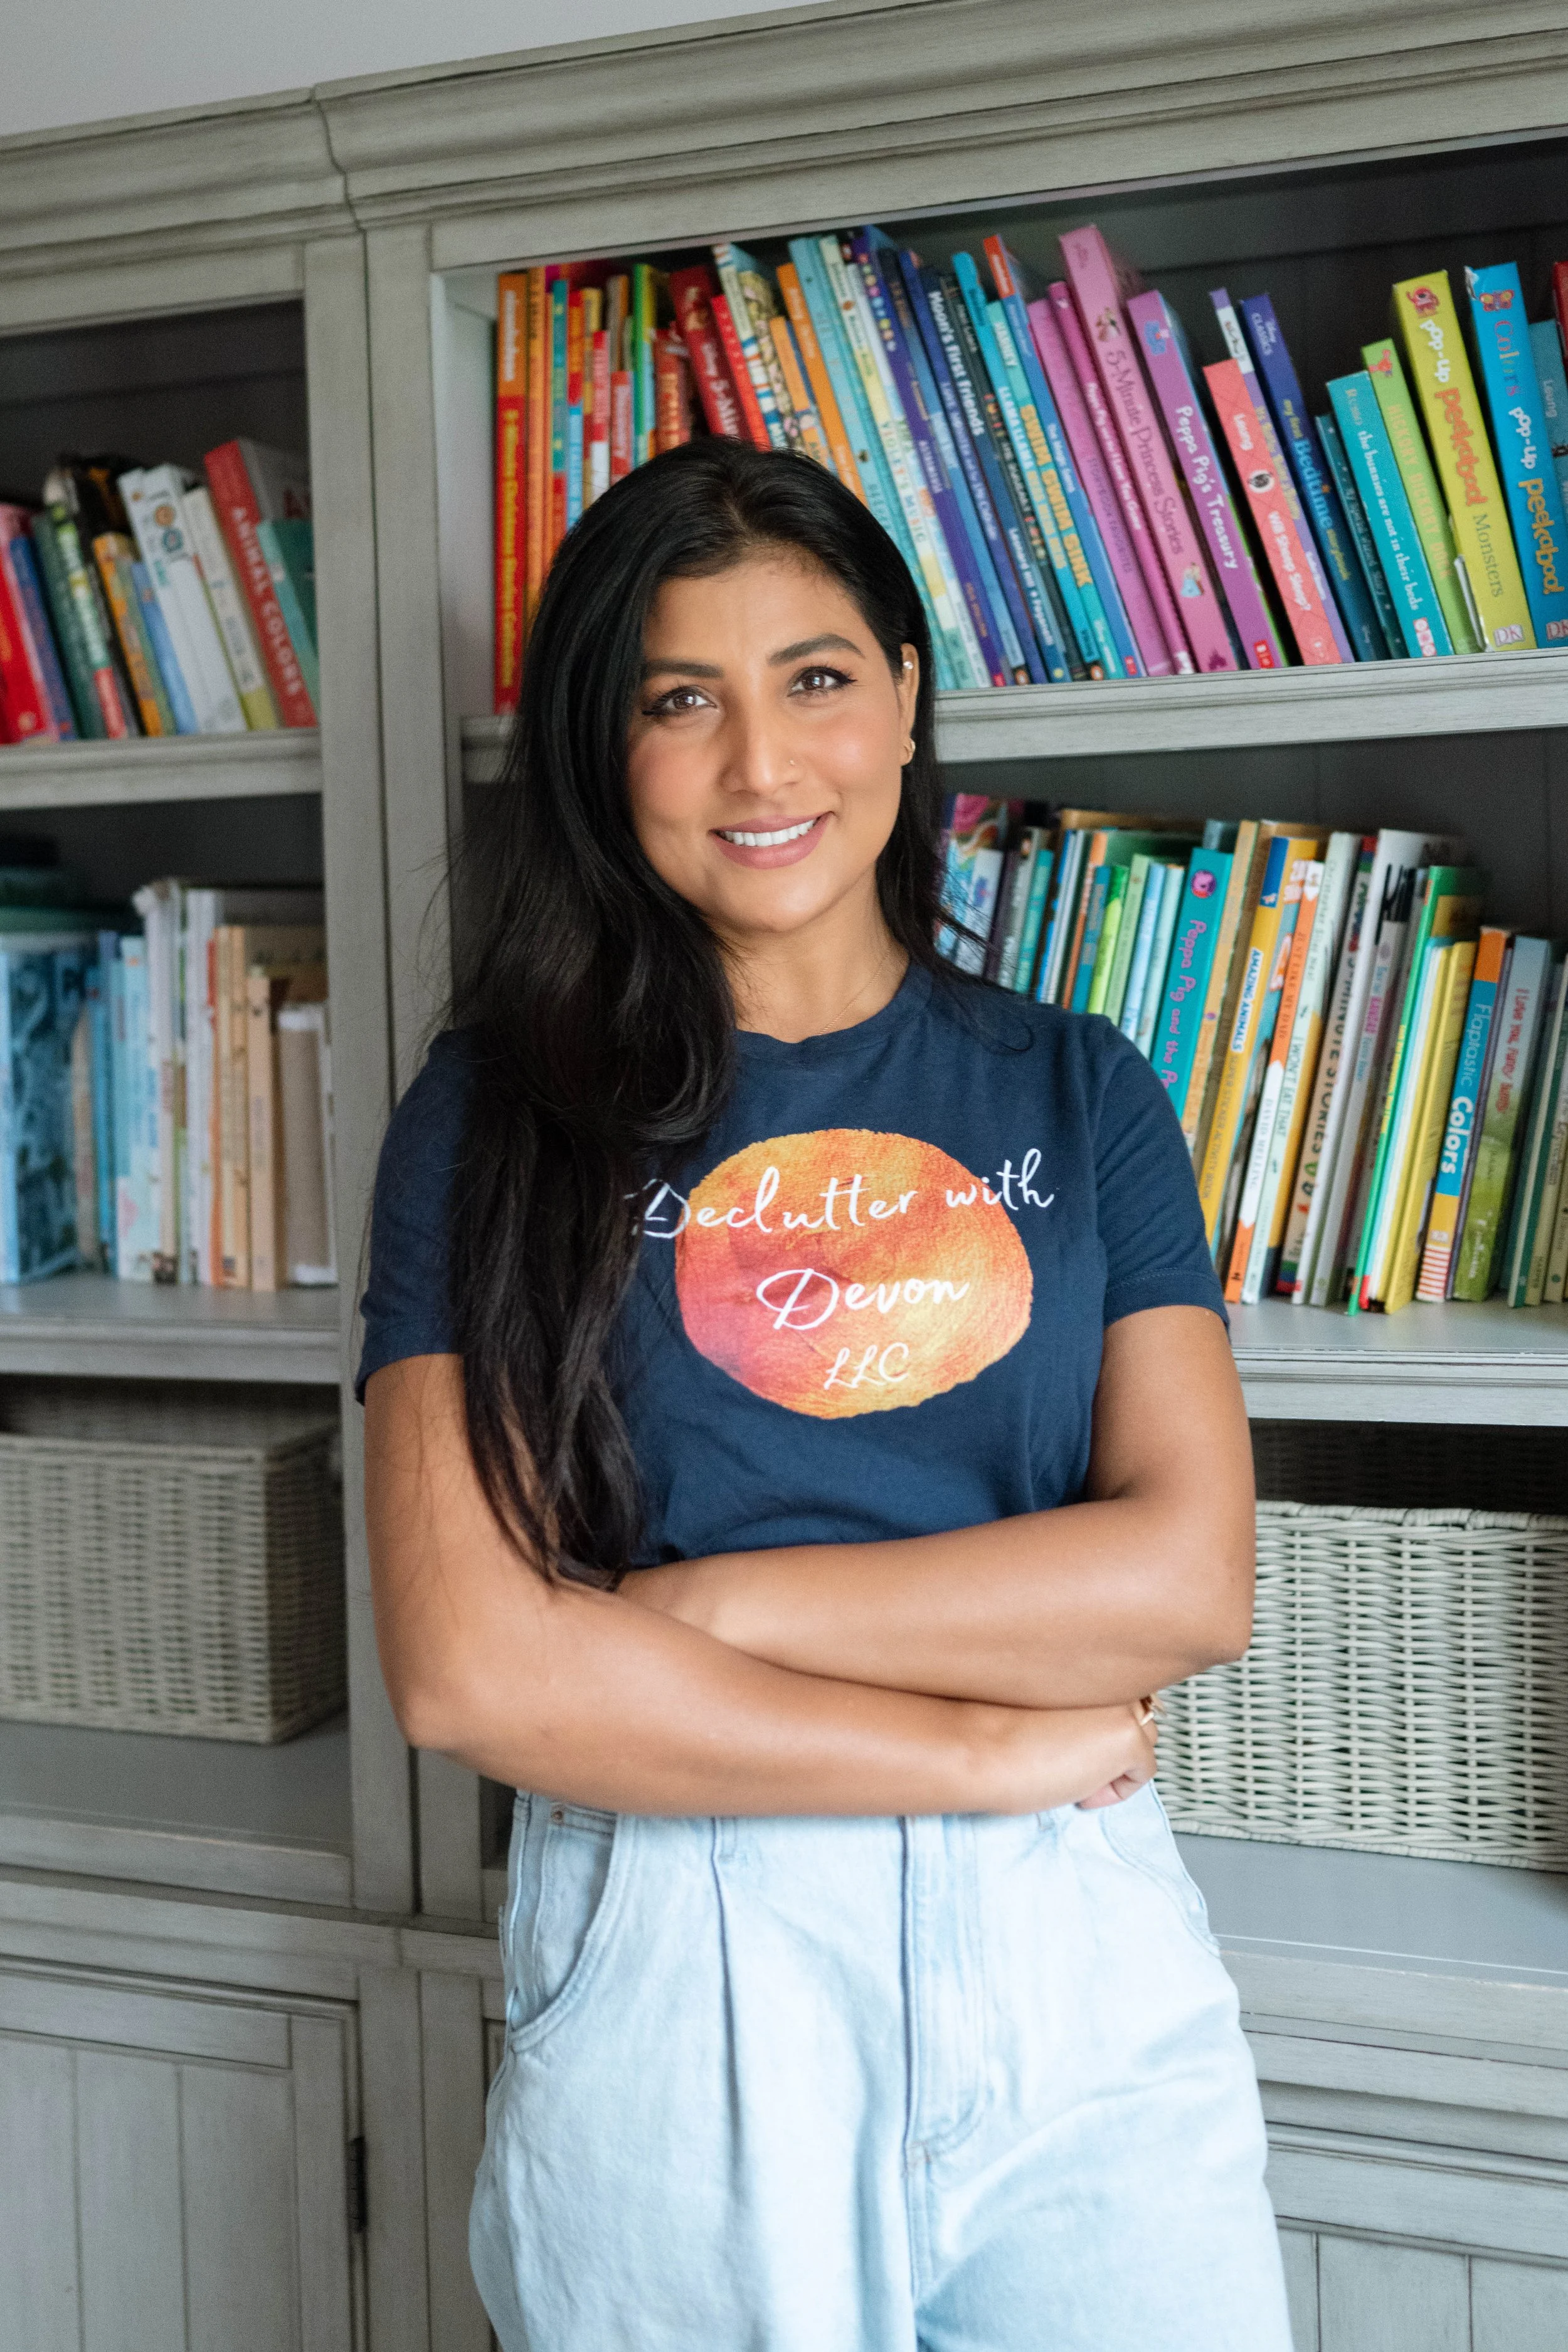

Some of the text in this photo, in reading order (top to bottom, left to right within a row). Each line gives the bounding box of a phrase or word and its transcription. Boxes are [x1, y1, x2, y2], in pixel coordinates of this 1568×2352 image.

[927, 289, 955, 345] Moon's
[1249, 310, 1274, 357] CLASSICS
[1492, 318, 1527, 398] Colors
[997, 384, 1020, 429] LLAMA
[1010, 426, 1035, 470] LLAMA
[1539, 379, 1560, 419] Leung
[1104, 348, 1188, 558] 5-Minute Princess Stories
[1229, 411, 1256, 453] Leung
[1419, 317, 1453, 386] pop-up
[1471, 512, 1507, 599] Monsters
[1508, 405, 1540, 473] pop-up
[881, 419, 912, 490] VIOLET'S
[903, 494, 927, 543] MUSIC
[1018, 403, 1052, 467] SWIM
[1040, 466, 1074, 532] SWIM
[1061, 532, 1092, 590] SINK
[1170, 403, 1243, 571] Peppa Pig's Treasury
[1291, 435, 1335, 531] Bedtime
[1386, 403, 1455, 582] HICKORY DICKORY DOCK
[1355, 428, 1426, 612] the bunnies are not in their beds
[1266, 509, 1312, 613] Will Sheep Sleep?
[231, 507, 273, 596] ANIMAL
[262, 600, 303, 697] COLORS
[1491, 622, 1526, 649] DK
[1174, 917, 1207, 971] Peppa
[1167, 1007, 1185, 1035] and
[1168, 973, 1197, 1004] Pig
[1230, 947, 1263, 1053] AMAZING ANIMALS
[1162, 1039, 1179, 1064] the
[1221, 1054, 1238, 1089] SUPER
[1284, 1044, 1303, 1084] WON'T
[1258, 1098, 1275, 1136] DAVID
[1280, 1086, 1295, 1107] EAT
[1439, 1001, 1493, 1176] Flaptastic Colors
[1274, 1107, 1291, 1138] THAT
[623, 1148, 1056, 1239] Declutter with
[756, 1268, 970, 1330] Devon
[824, 1342, 909, 1390] LLC
